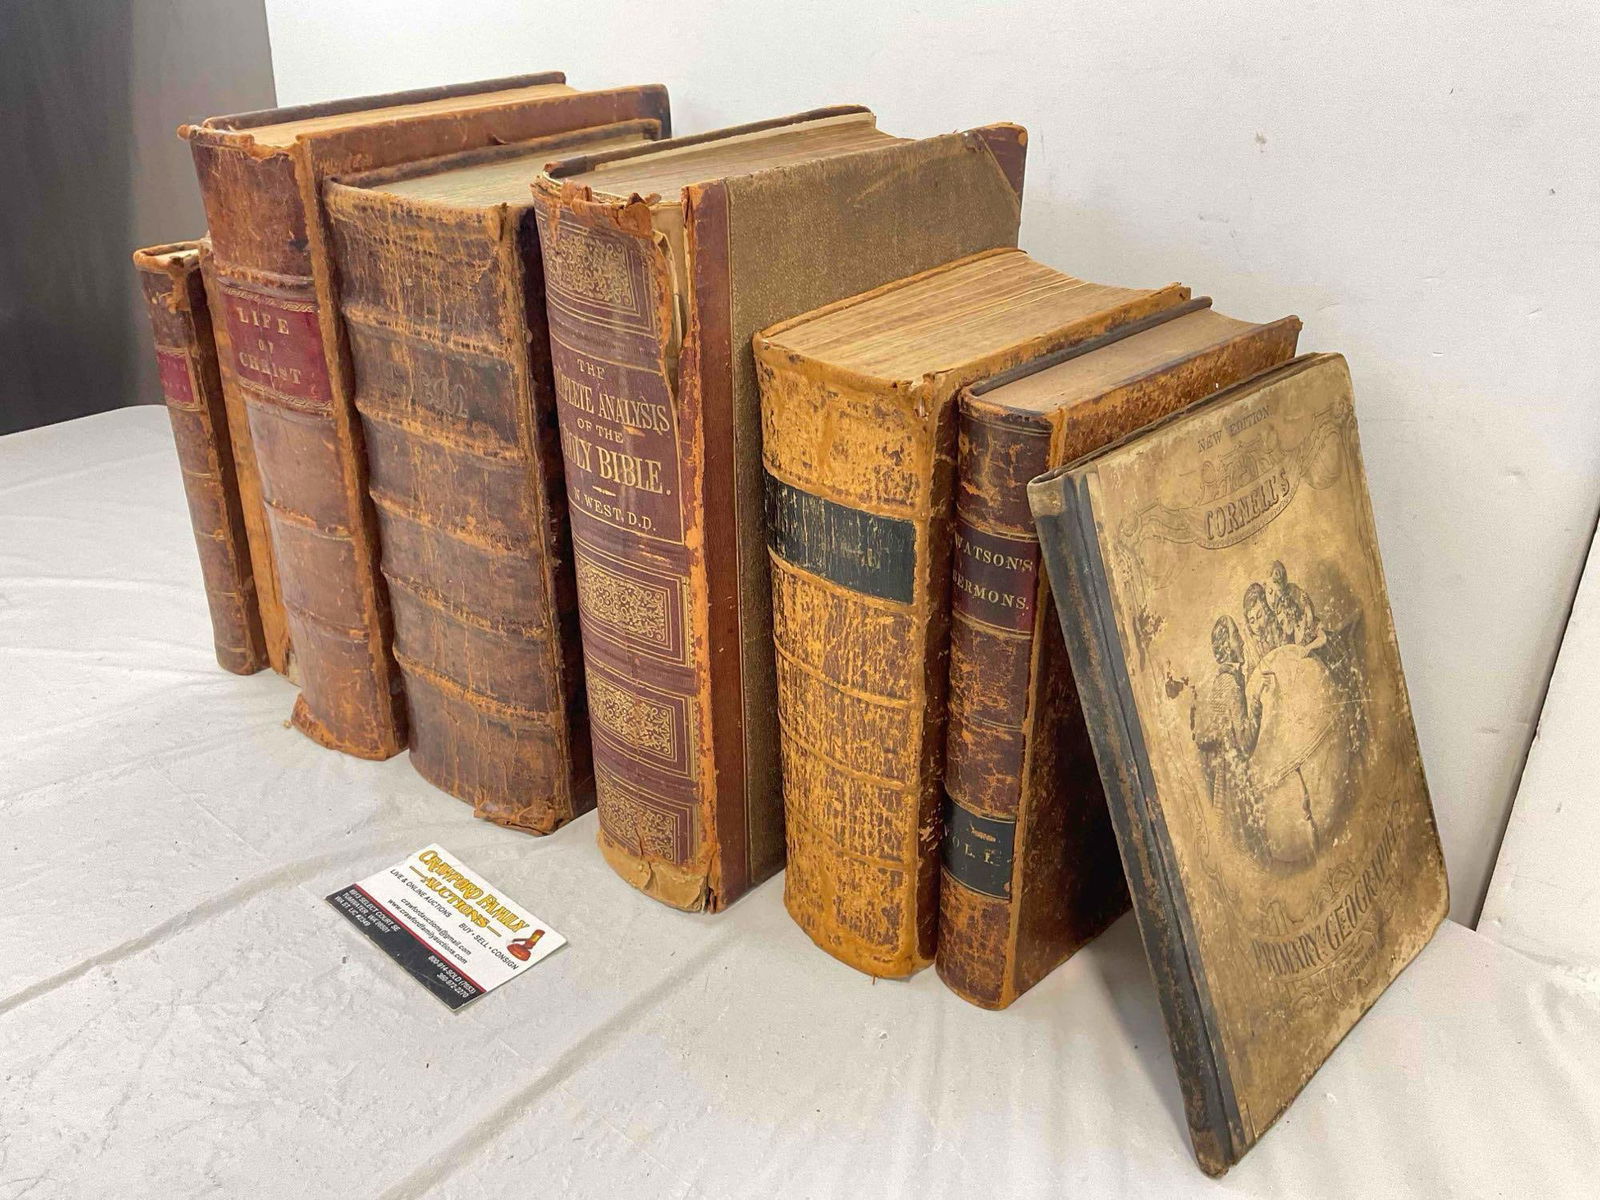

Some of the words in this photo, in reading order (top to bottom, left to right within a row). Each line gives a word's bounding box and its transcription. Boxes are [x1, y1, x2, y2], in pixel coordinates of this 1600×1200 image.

[236, 306, 290, 336] LIFE
[577, 358, 605, 380] THE
[577, 418, 592, 432] OF
[596, 426, 624, 444] THE
[599, 389, 670, 432] ANALYSIS
[1198, 430, 1222, 453] NEW
[596, 445, 672, 496] BIBLE.
[1206, 467, 1290, 540] CORNELL'S
[955, 530, 1033, 572] WATSON'S
[390, 869, 403, 880] LIVE
[406, 882, 426, 898] ONLINE
[424, 894, 452, 918] AUCTIONS
[419, 850, 484, 900] CRAWFORD
[476, 894, 529, 932] FAMILY
[421, 877, 490, 928] AUCTIONS
[459, 922, 473, 935] BUY
[473, 934, 489, 949] SELL
[490, 948, 519, 970] CONSIGN
